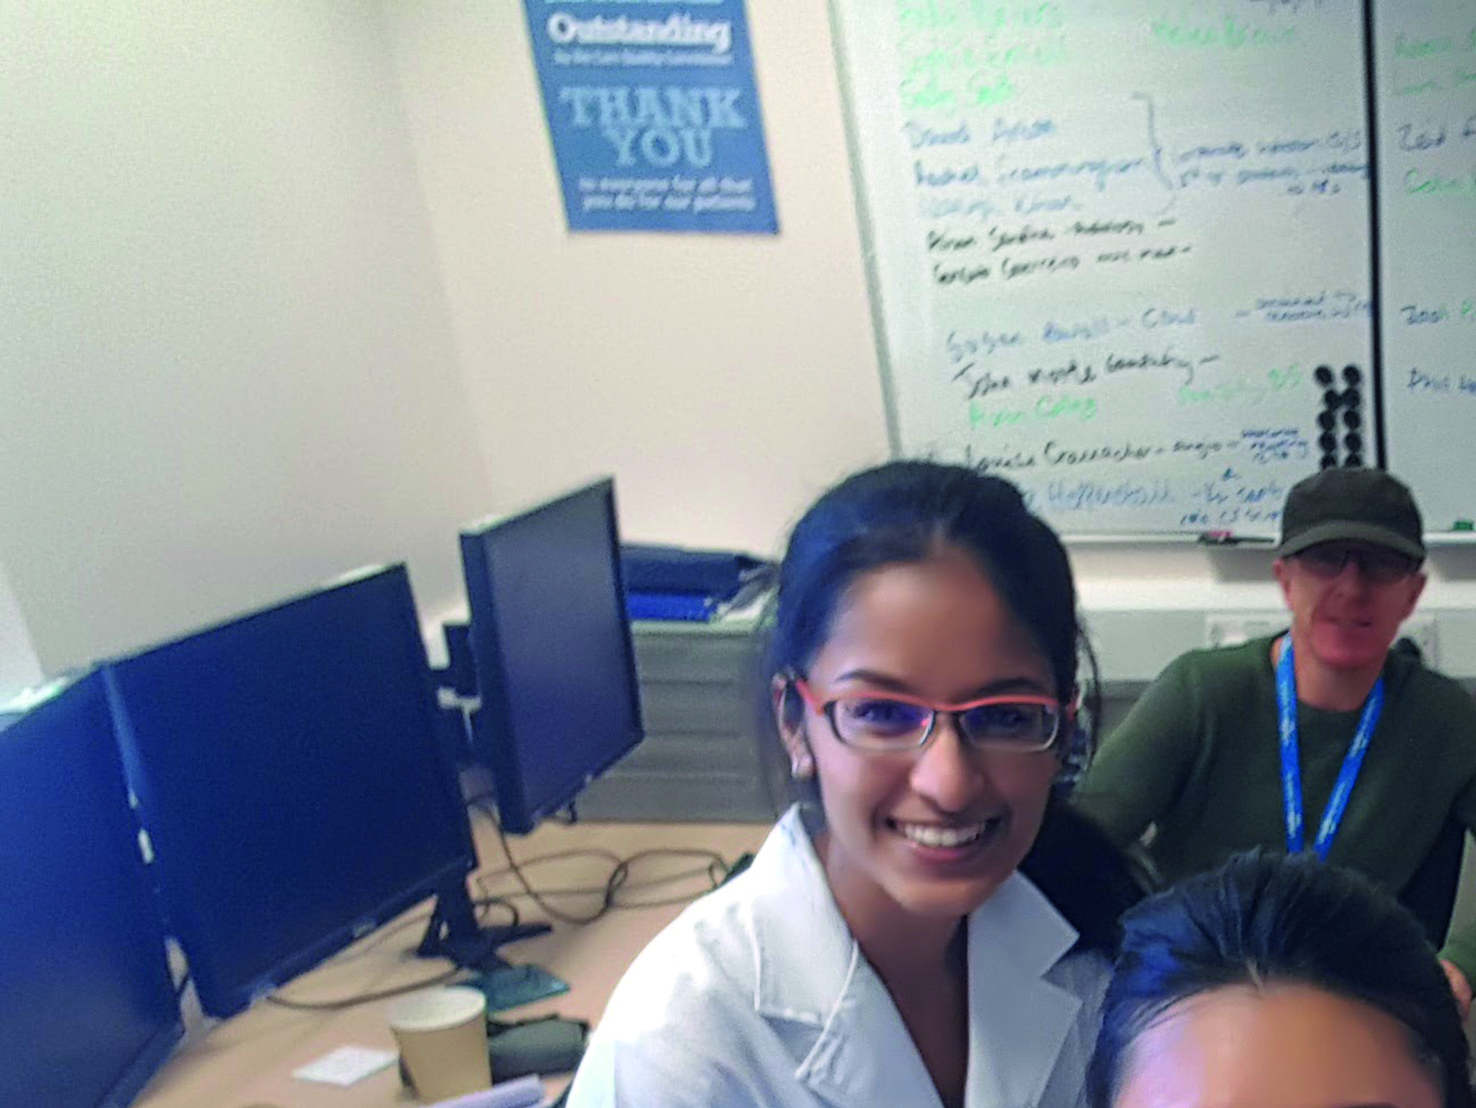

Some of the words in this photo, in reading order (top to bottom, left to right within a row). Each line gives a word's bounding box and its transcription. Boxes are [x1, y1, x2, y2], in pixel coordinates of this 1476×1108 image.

[547, 12, 731, 54] Outstanding
[559, 86, 746, 128] THANK
[602, 128, 713, 167] YOU
